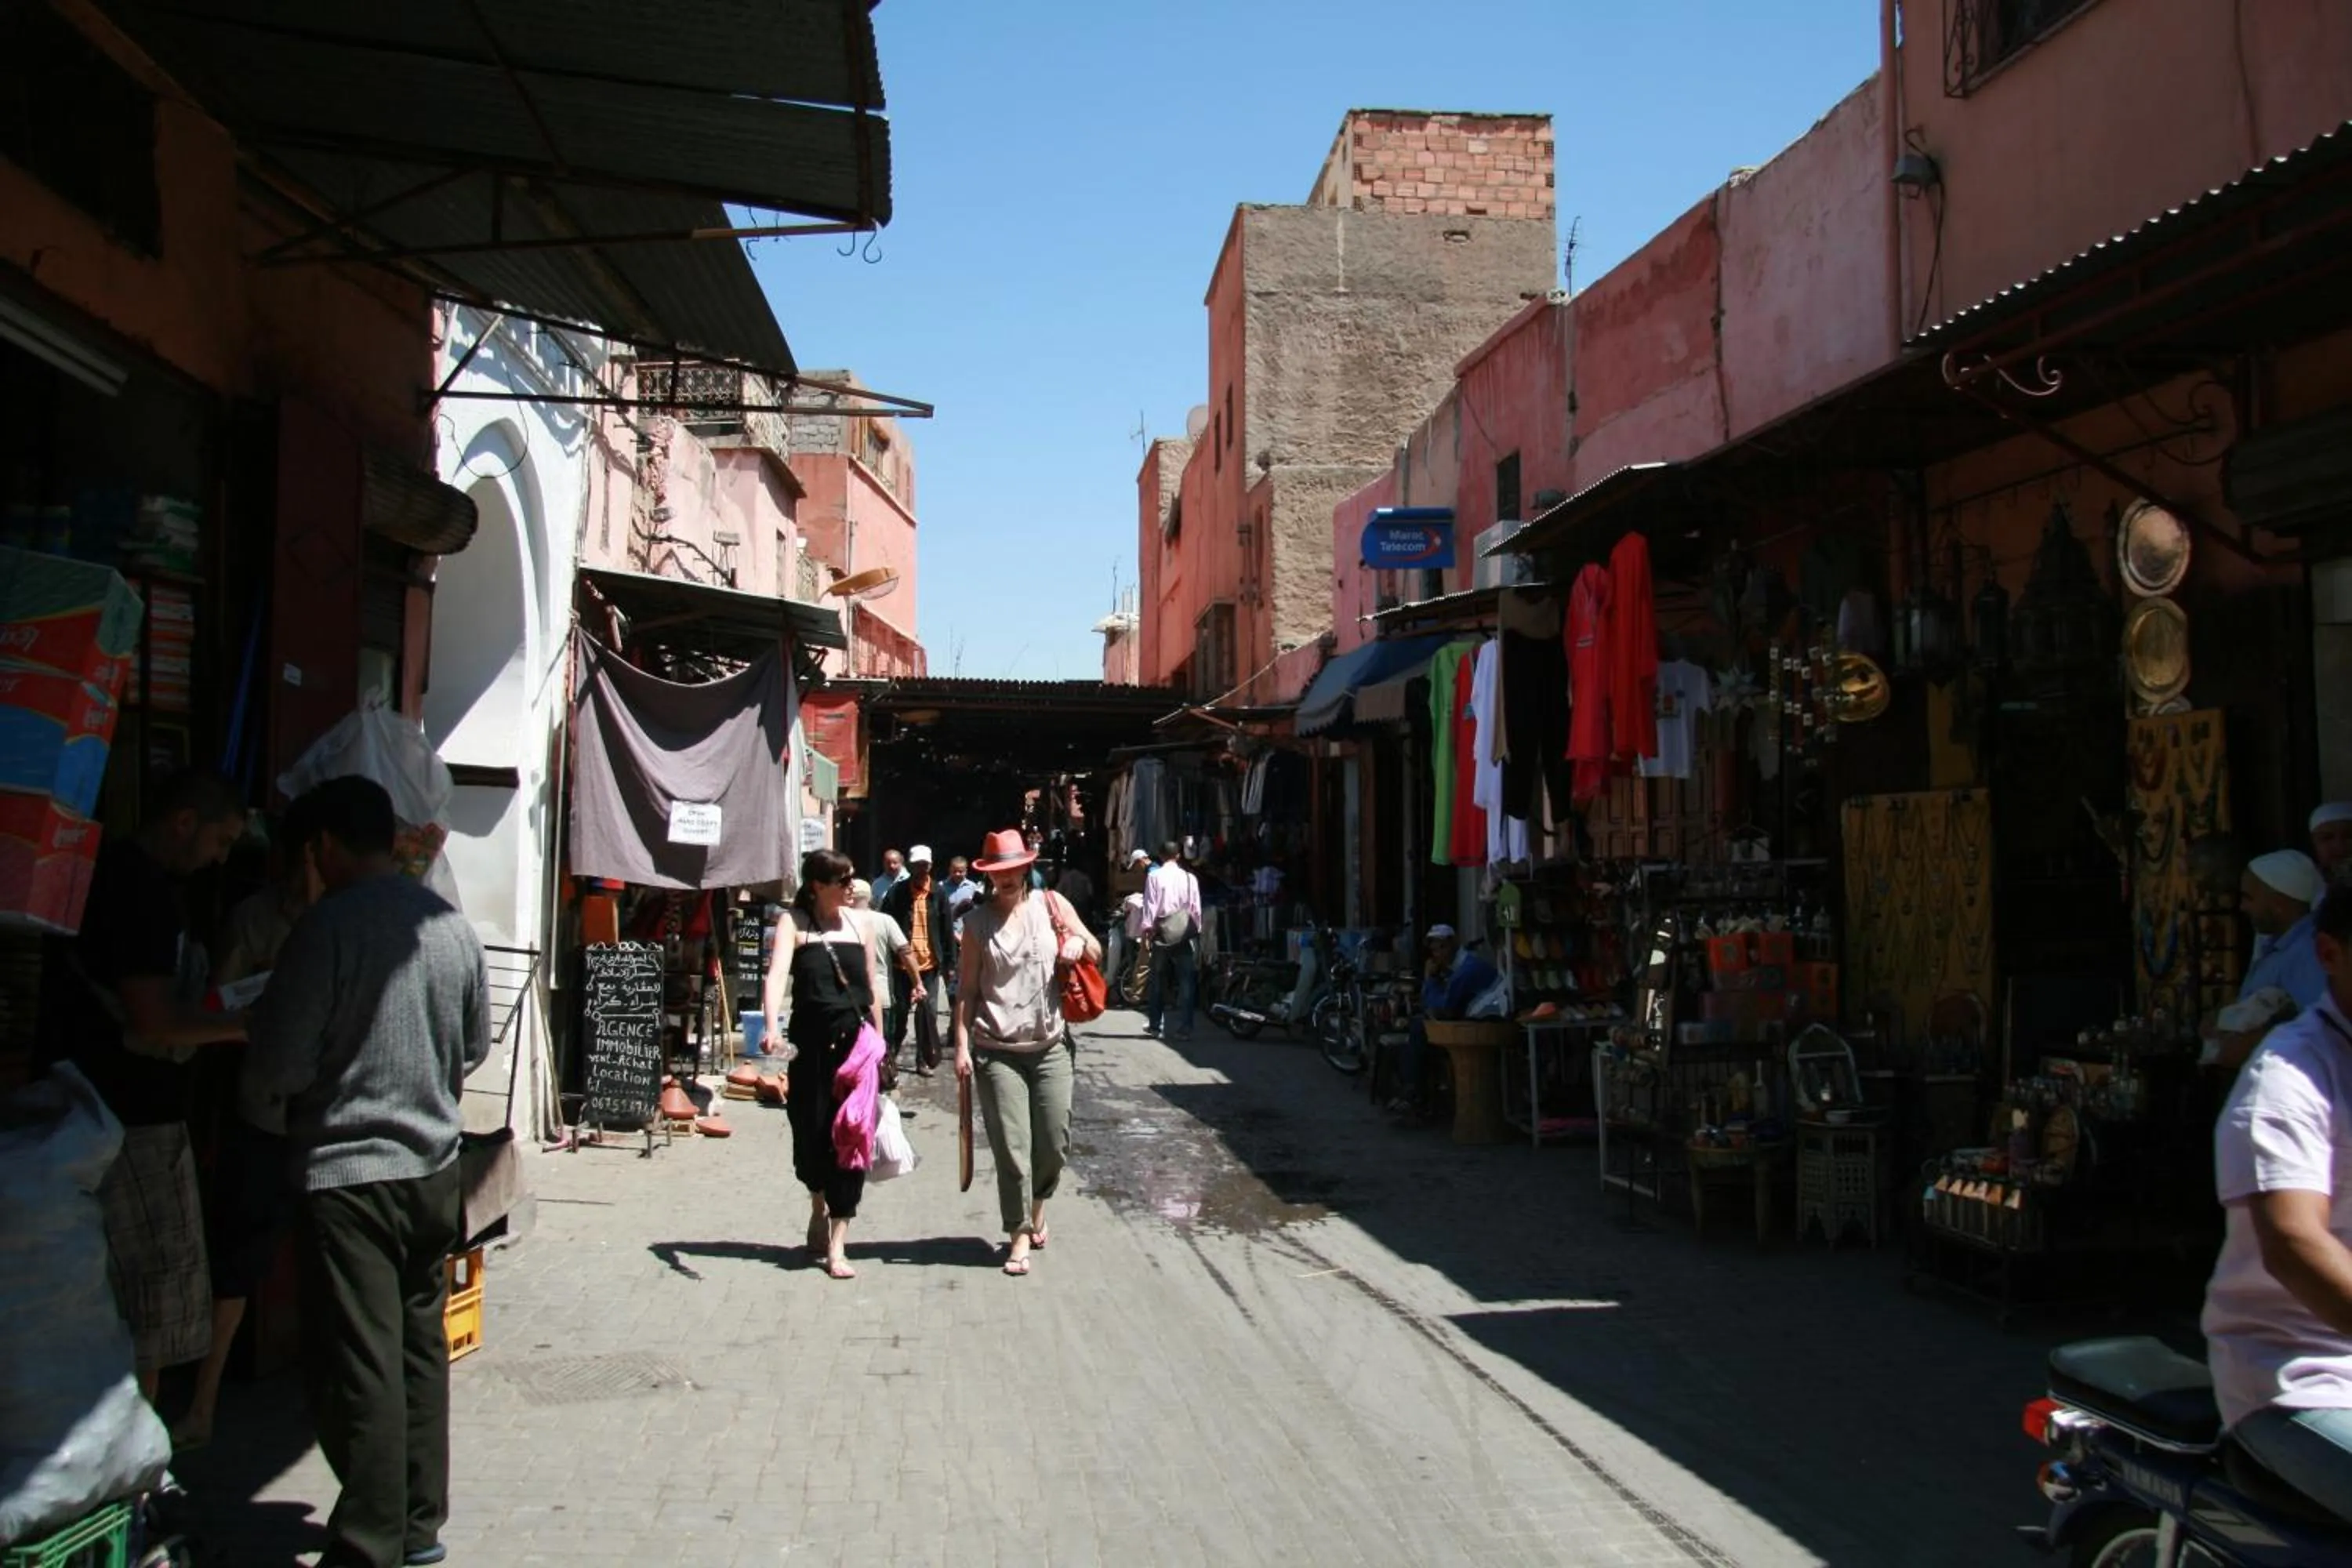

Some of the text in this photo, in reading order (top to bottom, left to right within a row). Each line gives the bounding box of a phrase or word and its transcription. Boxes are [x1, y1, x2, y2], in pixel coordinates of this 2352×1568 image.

[1389, 530, 1425, 540] Maroc
[1380, 541, 1426, 552] Telecom
[597, 1019, 655, 1038] AGENCE
